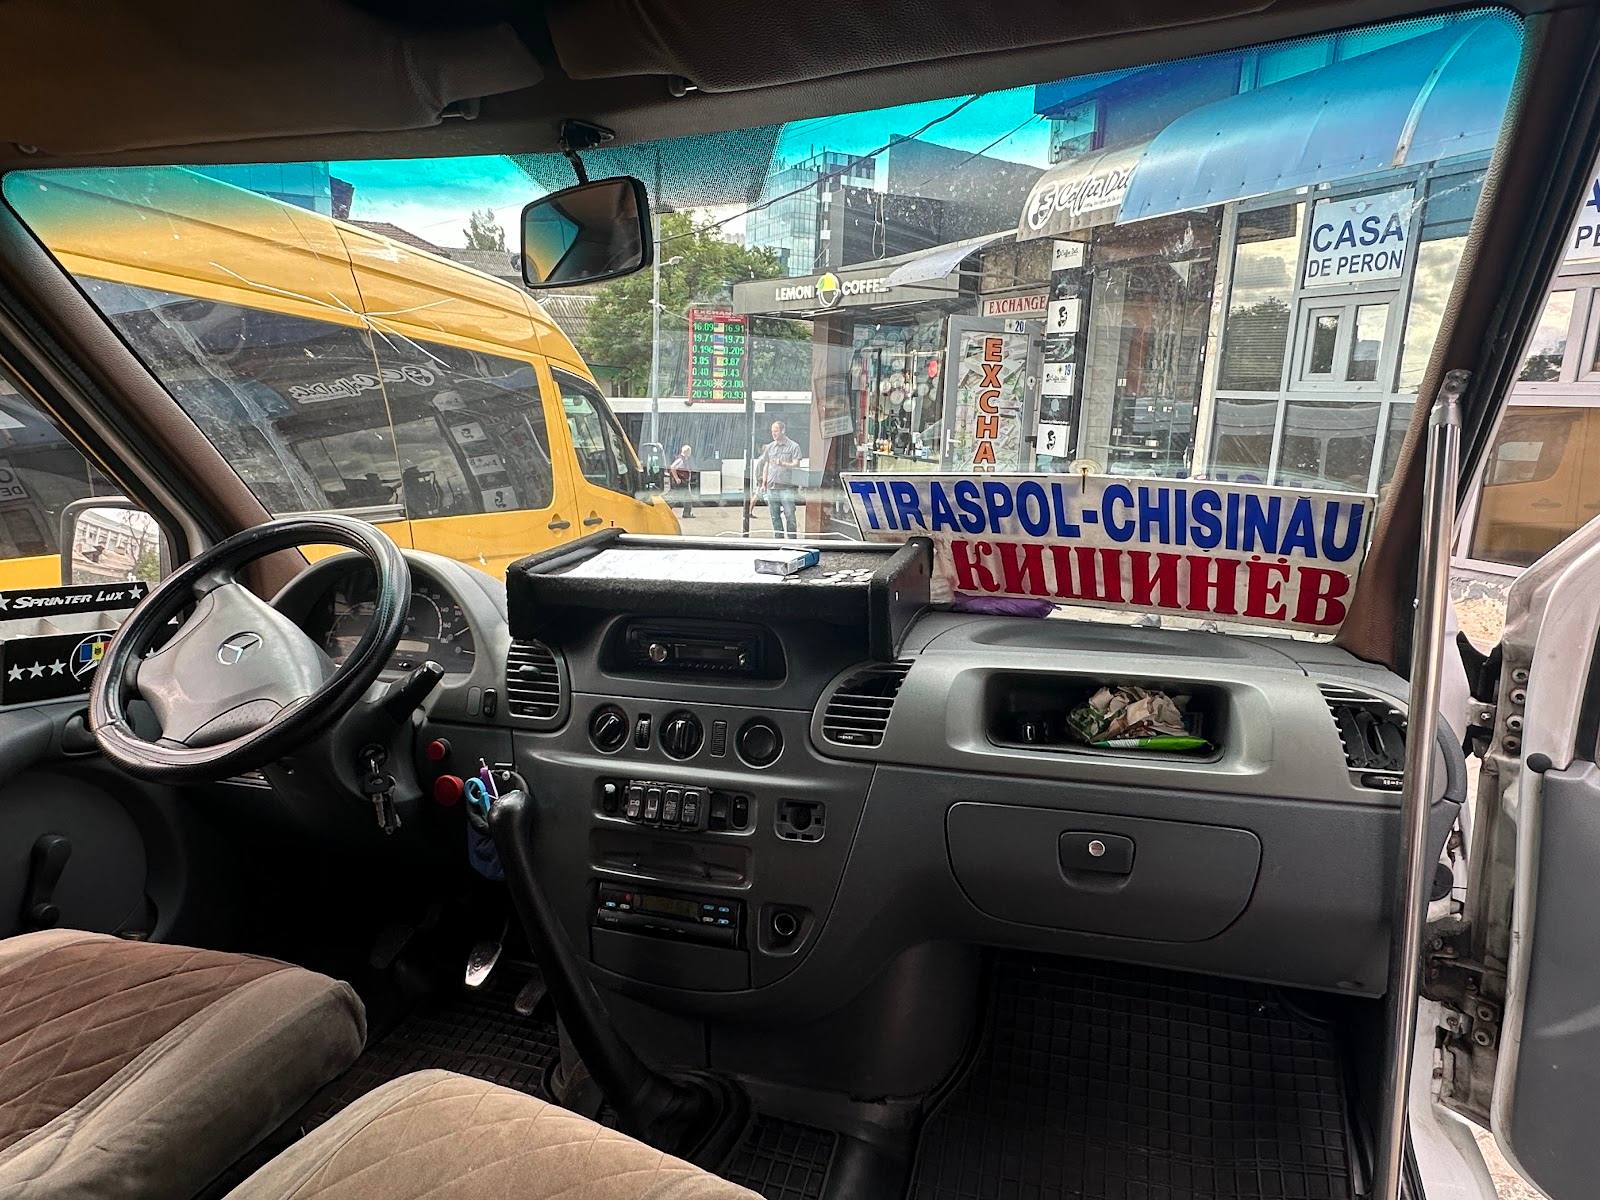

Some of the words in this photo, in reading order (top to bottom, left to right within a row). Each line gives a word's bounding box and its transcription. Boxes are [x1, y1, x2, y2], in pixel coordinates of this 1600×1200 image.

[1313, 213, 1404, 252] CASA
[1308, 258, 1331, 278] DE
[1337, 249, 1402, 275] PERON
[775, 285, 815, 301] LEMON
[989, 295, 1045, 314] EXCHANGE
[693, 309, 738, 318] EXCHAN
[725, 324, 744, 333] 16.91
[1015, 321, 1024, 332] 20
[693, 334, 714, 342] 19.71
[724, 335, 744, 344] 19.73
[724, 347, 744, 355] 0.205
[692, 390, 713, 398] 20.91
[973, 338, 1003, 473] EXCHA
[951, 540, 1352, 627] КИШИНЁВ
